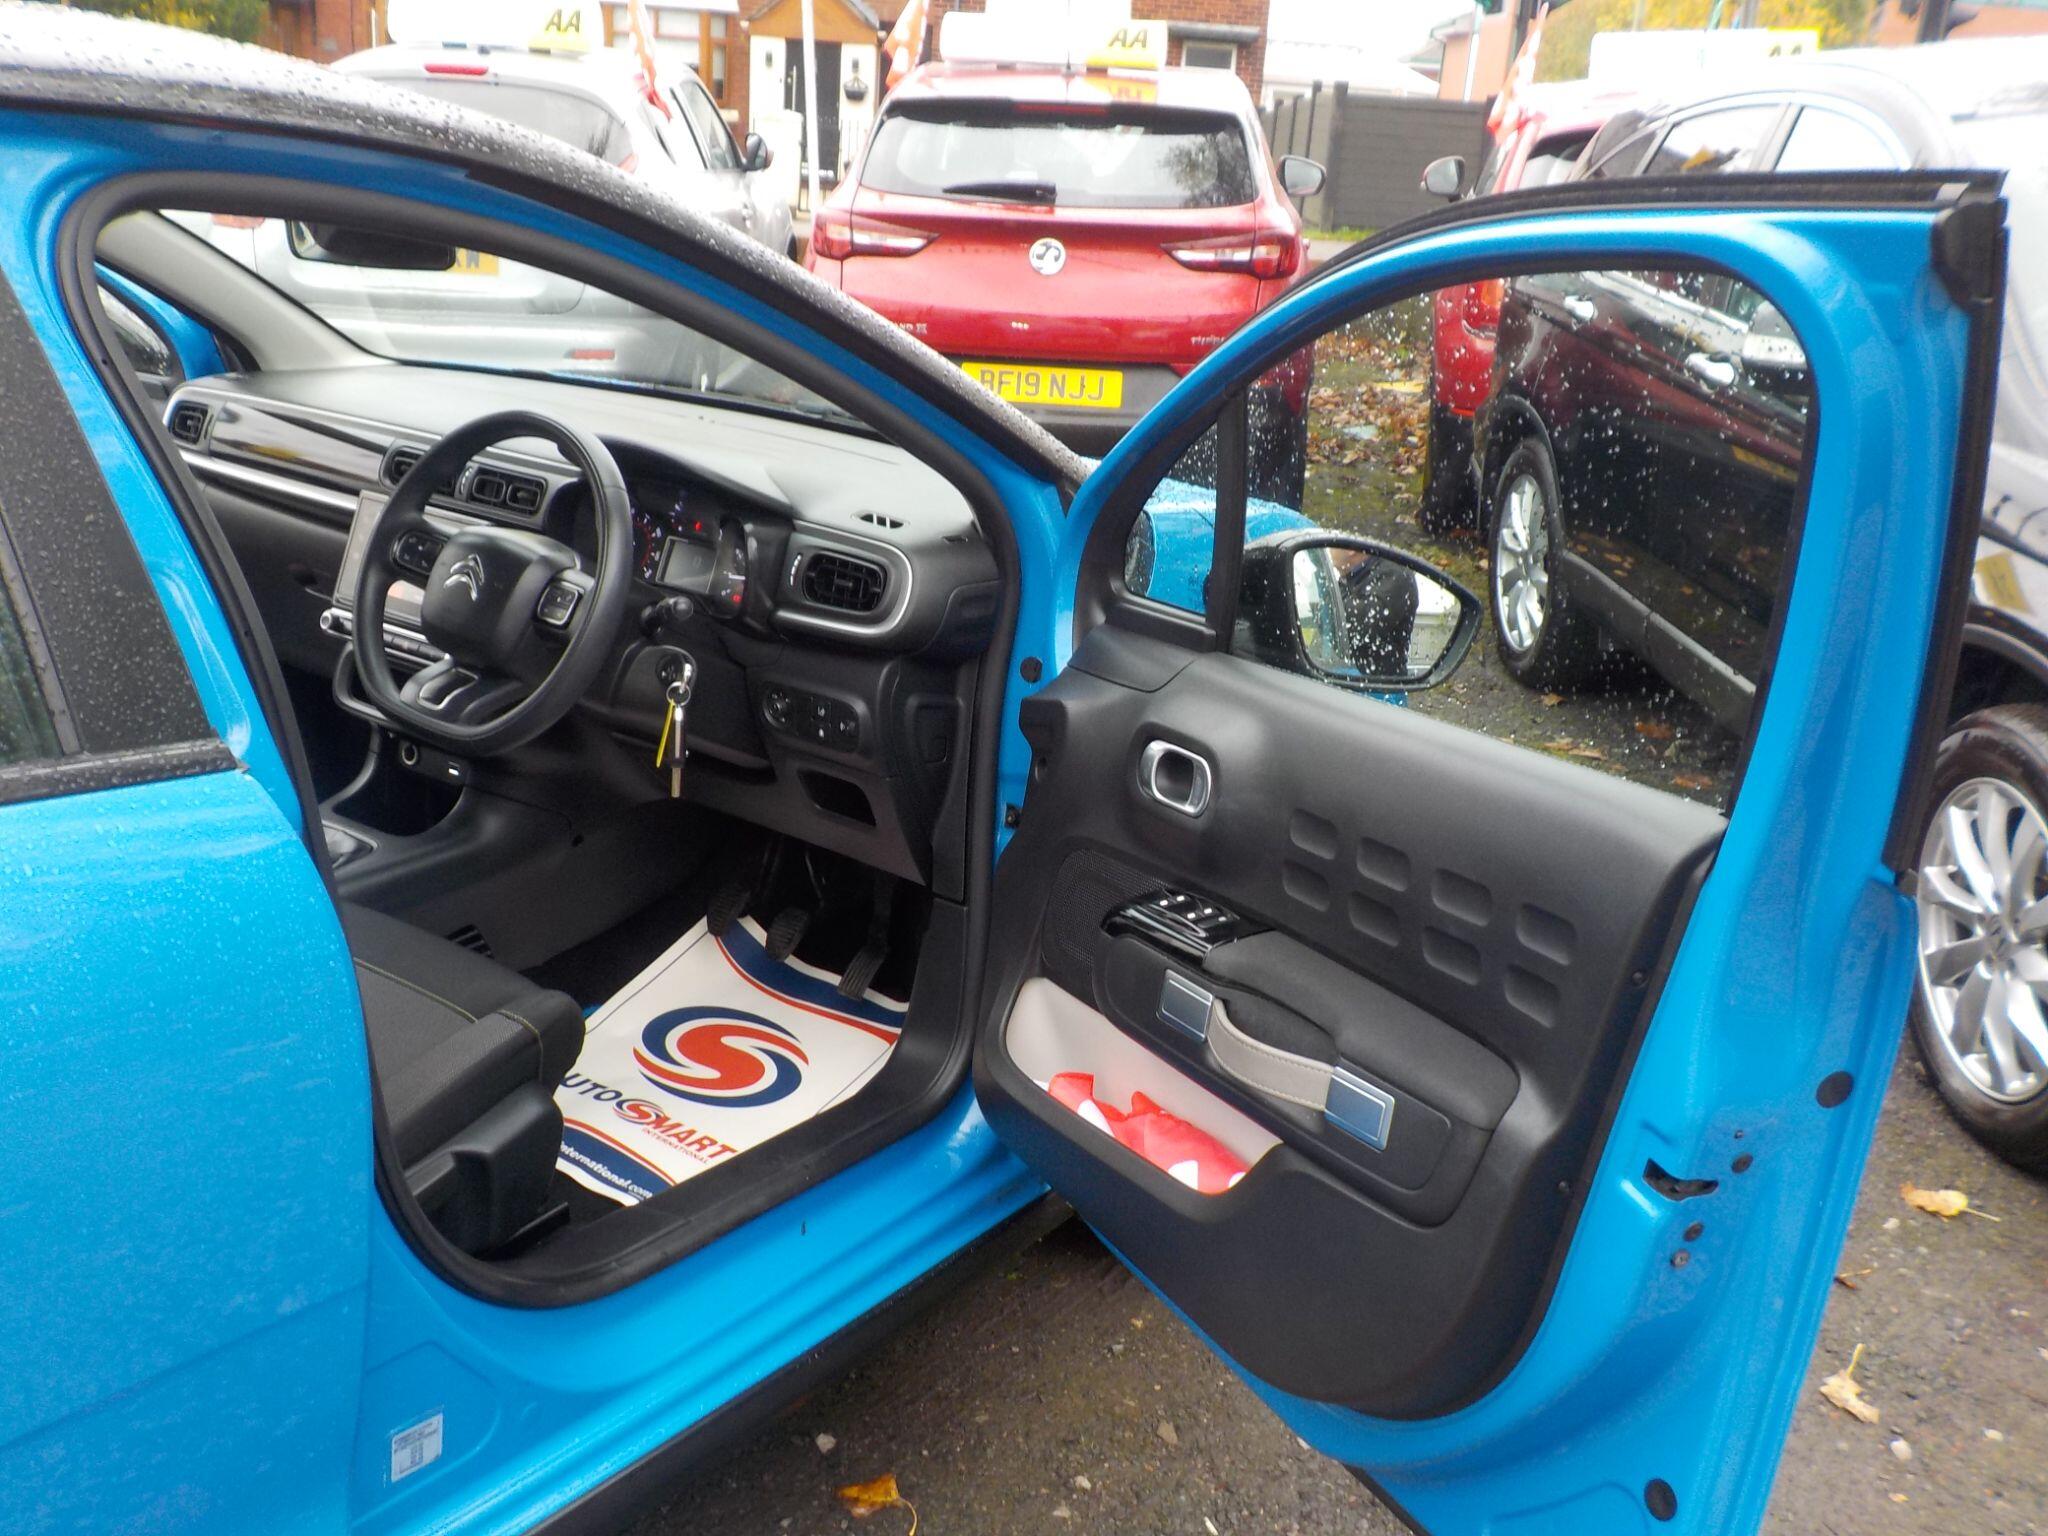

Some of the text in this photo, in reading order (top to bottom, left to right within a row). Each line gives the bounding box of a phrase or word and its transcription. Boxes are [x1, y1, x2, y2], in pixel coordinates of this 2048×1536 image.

[545, 8, 580, 32] AA
[1108, 28, 1147, 48] AA
[1049, 373, 1104, 401] NJJ
[560, 1073, 738, 1159] UTOSMART
[641, 1127, 710, 1164] INTERNATIONAL
